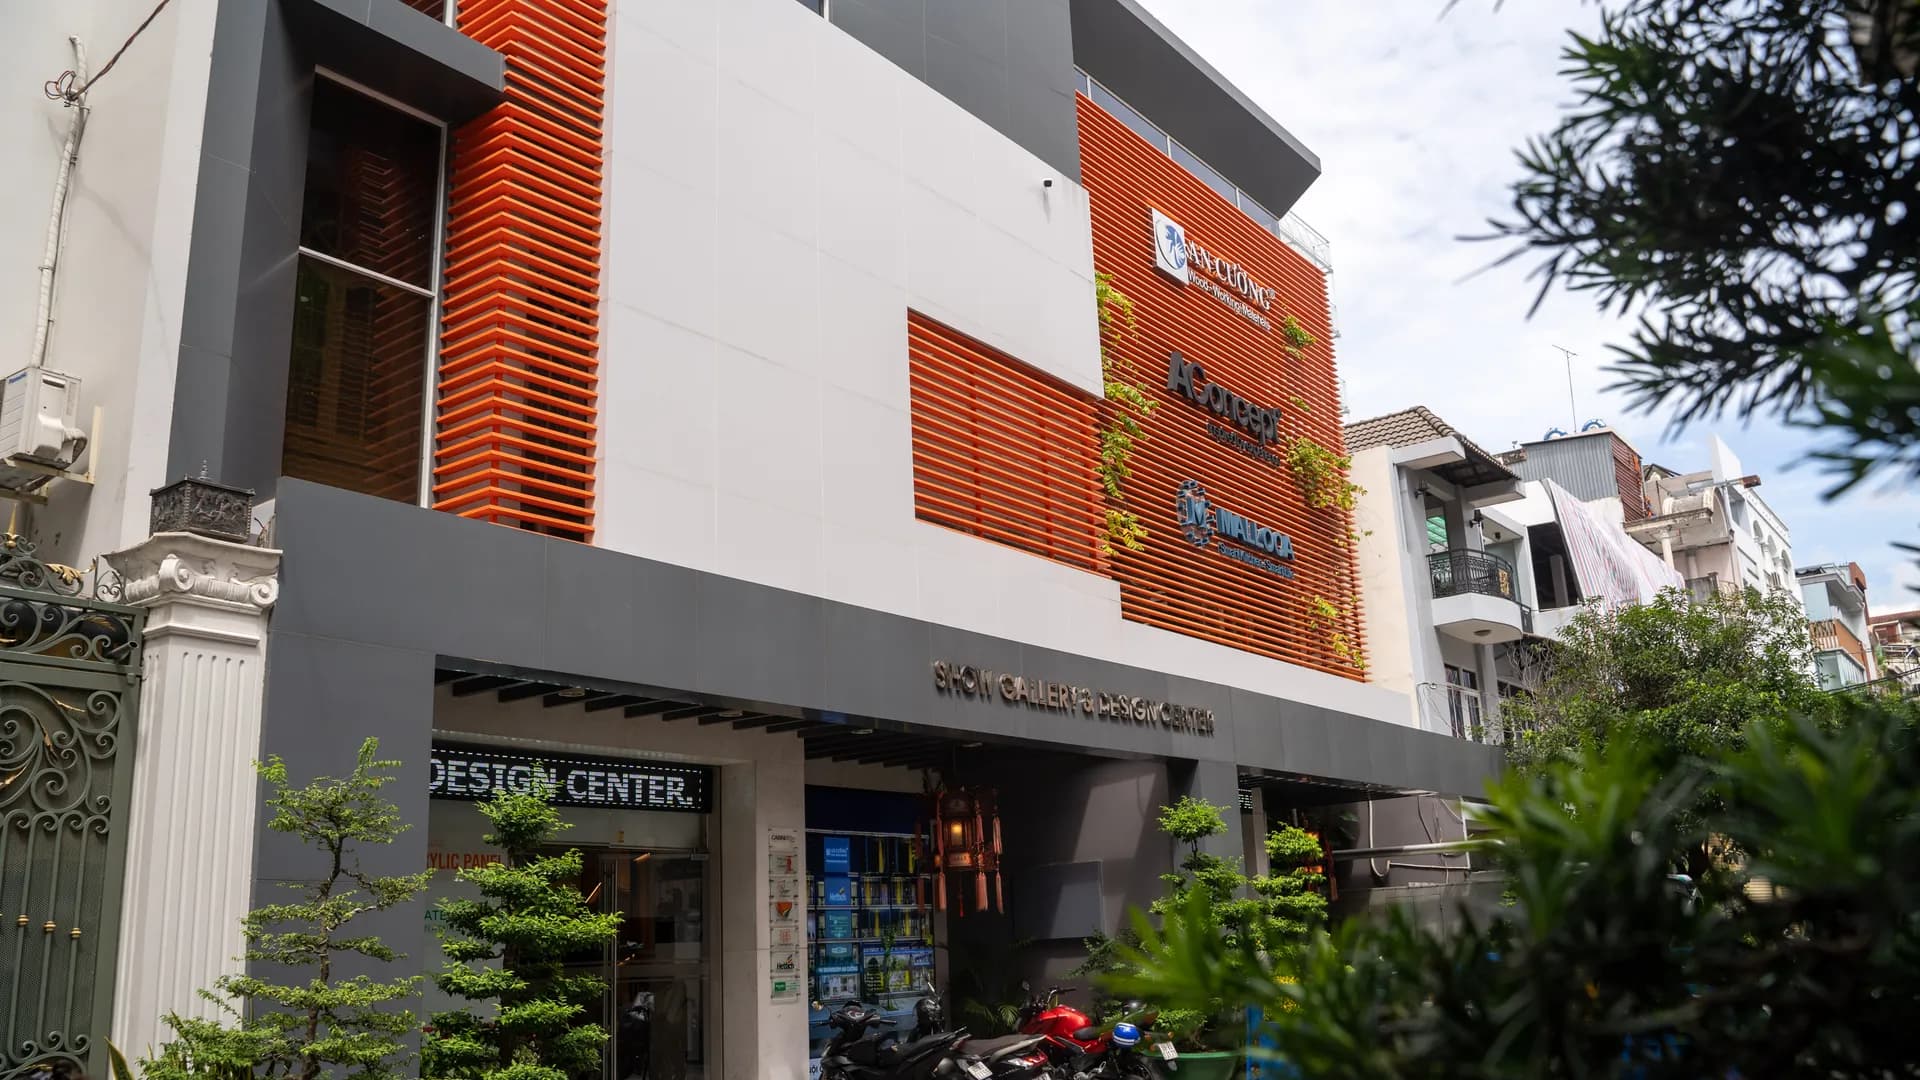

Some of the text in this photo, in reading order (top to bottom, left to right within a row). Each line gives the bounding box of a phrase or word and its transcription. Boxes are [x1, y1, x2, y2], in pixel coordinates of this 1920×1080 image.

[934, 660, 993, 695] SHOW
[1000, 673, 1078, 709] GALLERY
[1097, 691, 1158, 722] DESIGN
[1160, 702, 1215, 734] CENTER
[429, 758, 557, 798] DESIGN
